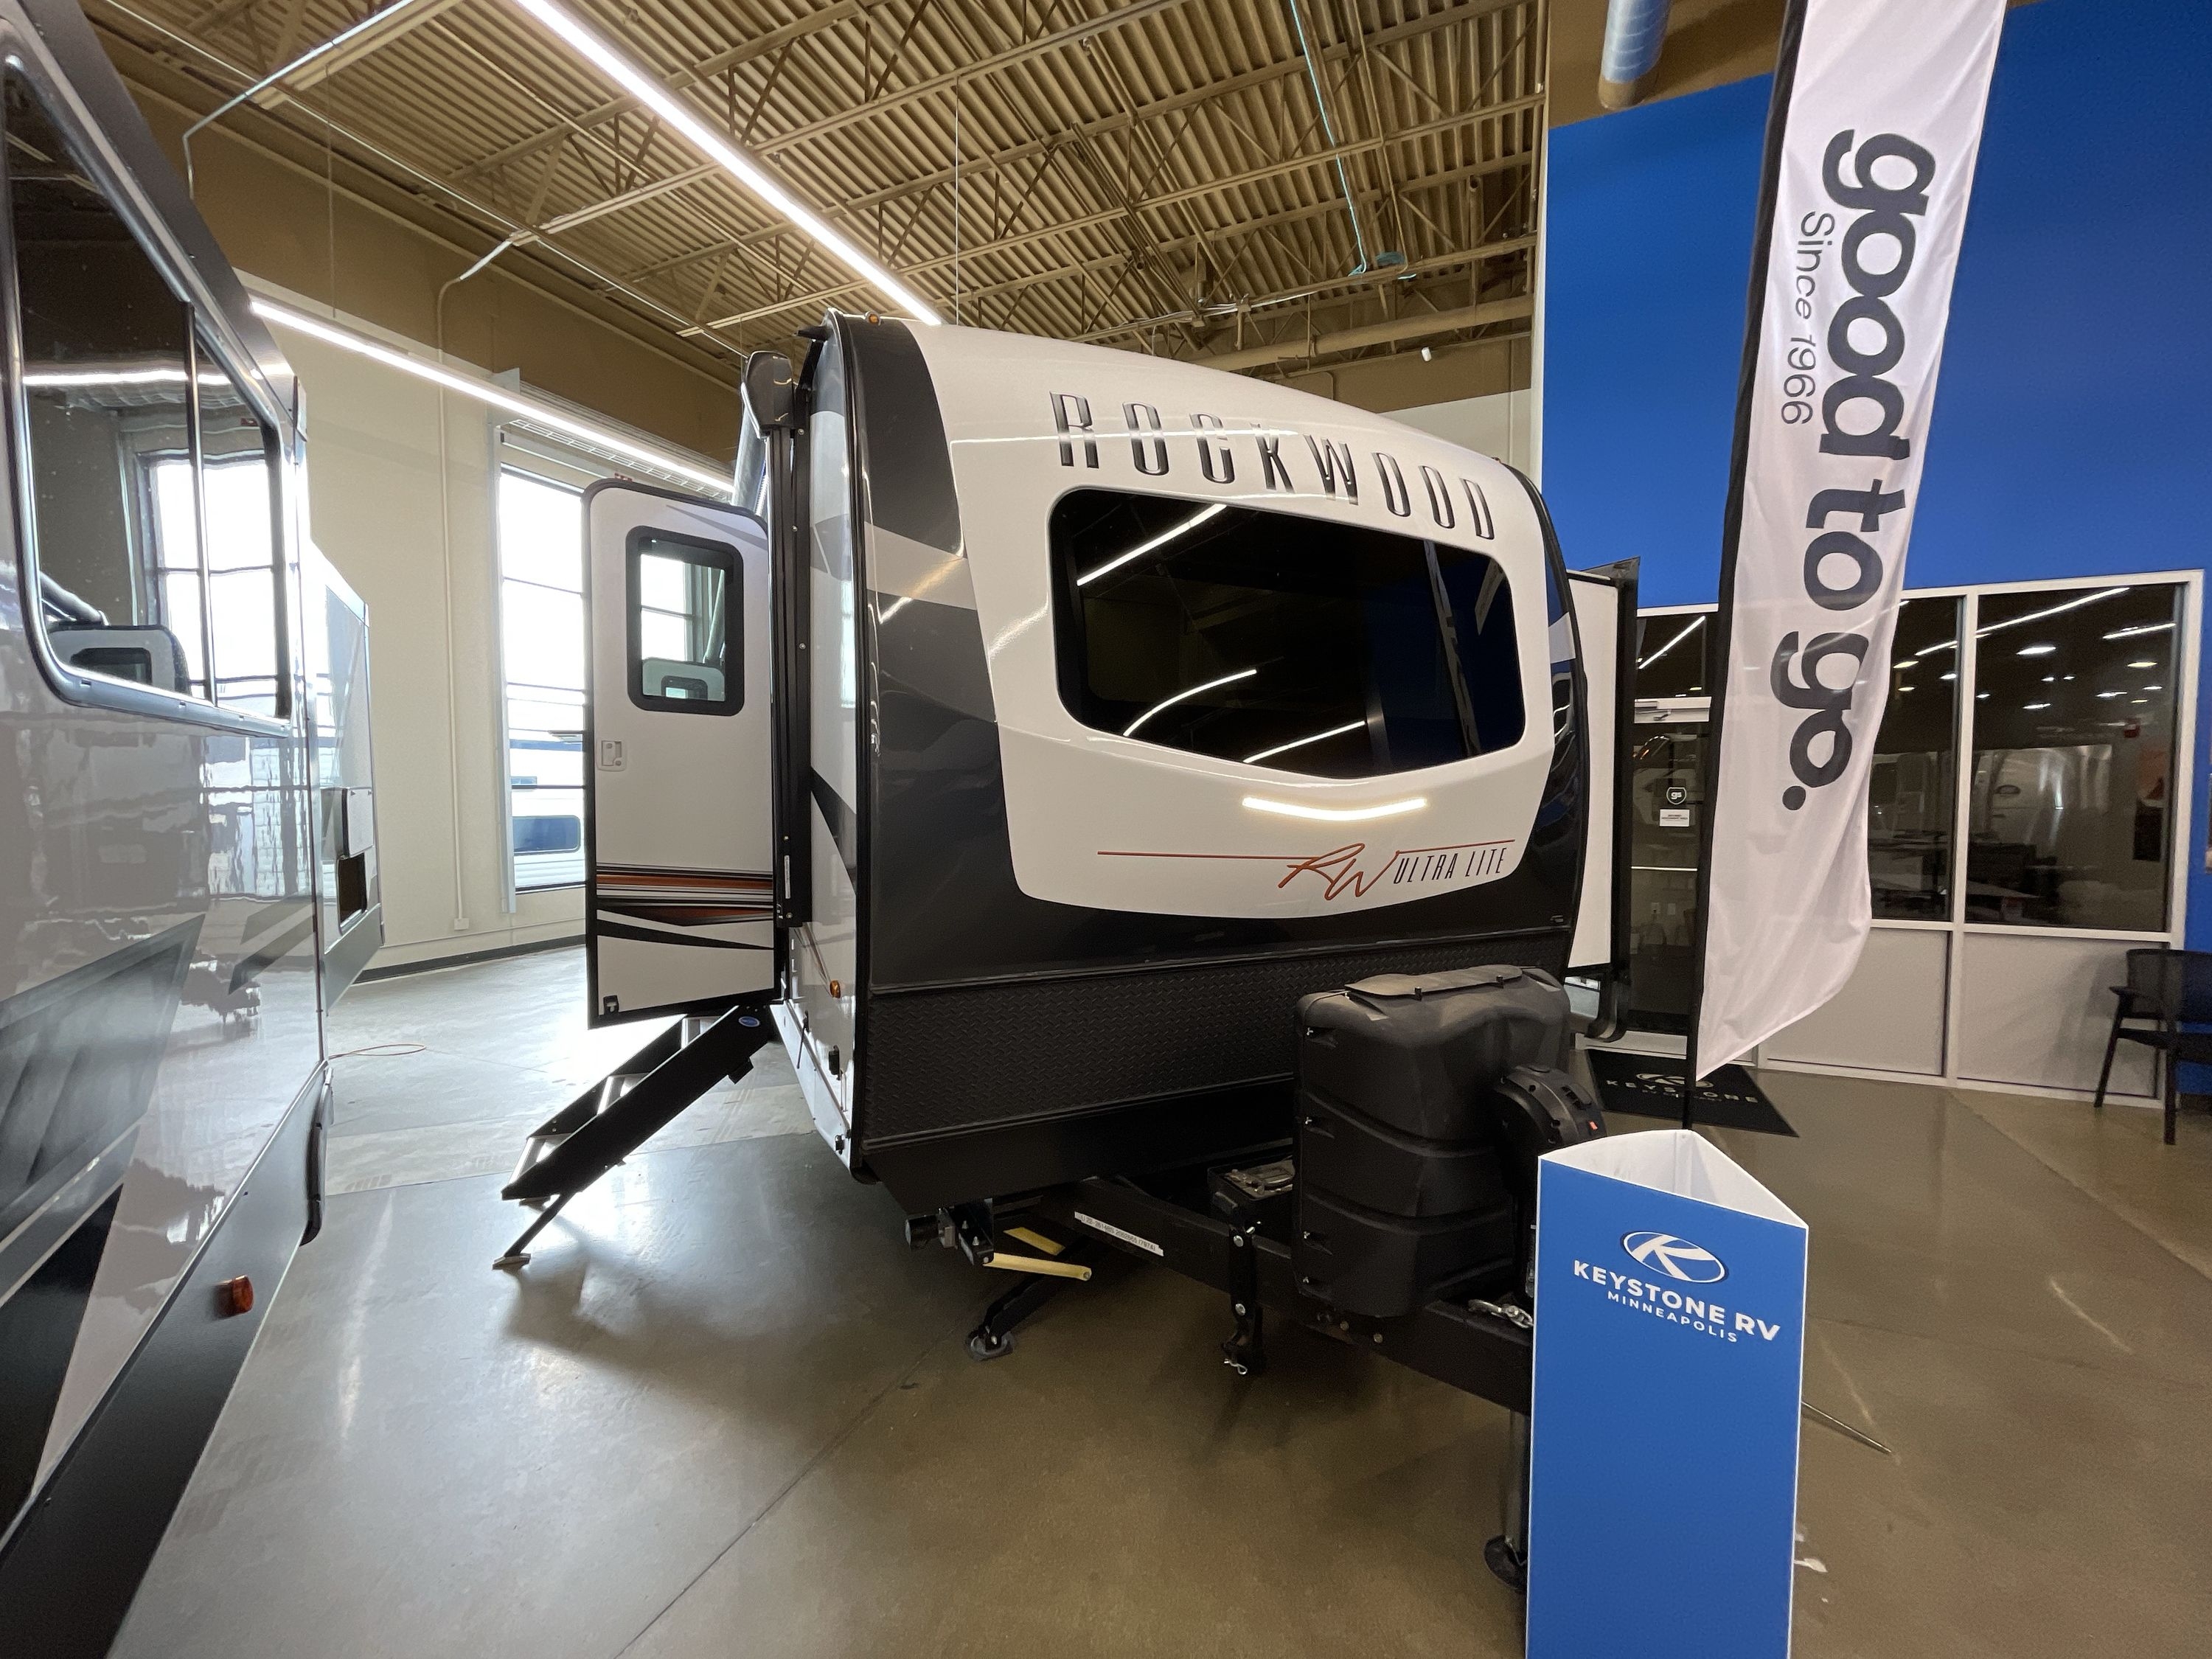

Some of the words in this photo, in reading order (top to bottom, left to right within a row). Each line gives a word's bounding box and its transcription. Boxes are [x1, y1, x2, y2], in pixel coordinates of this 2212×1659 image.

[1795, 210, 1835, 320] Since
[1819, 128, 1937, 461] good
[1781, 334, 1818, 425] 1966
[1049, 390, 1496, 540] ROCKWOOD
[1804, 479, 1907, 611] to
[1770, 630, 1870, 811] go.
[1393, 852, 1459, 885] ULTRA
[1464, 847, 1508, 877] LITE
[1606, 1079, 1759, 1104] KEYSONE
[1573, 1259, 1725, 1326] KEYSTONE
[1735, 1311, 1781, 1341] RV
[1607, 1290, 1738, 1343] MINNEAPOLIS
